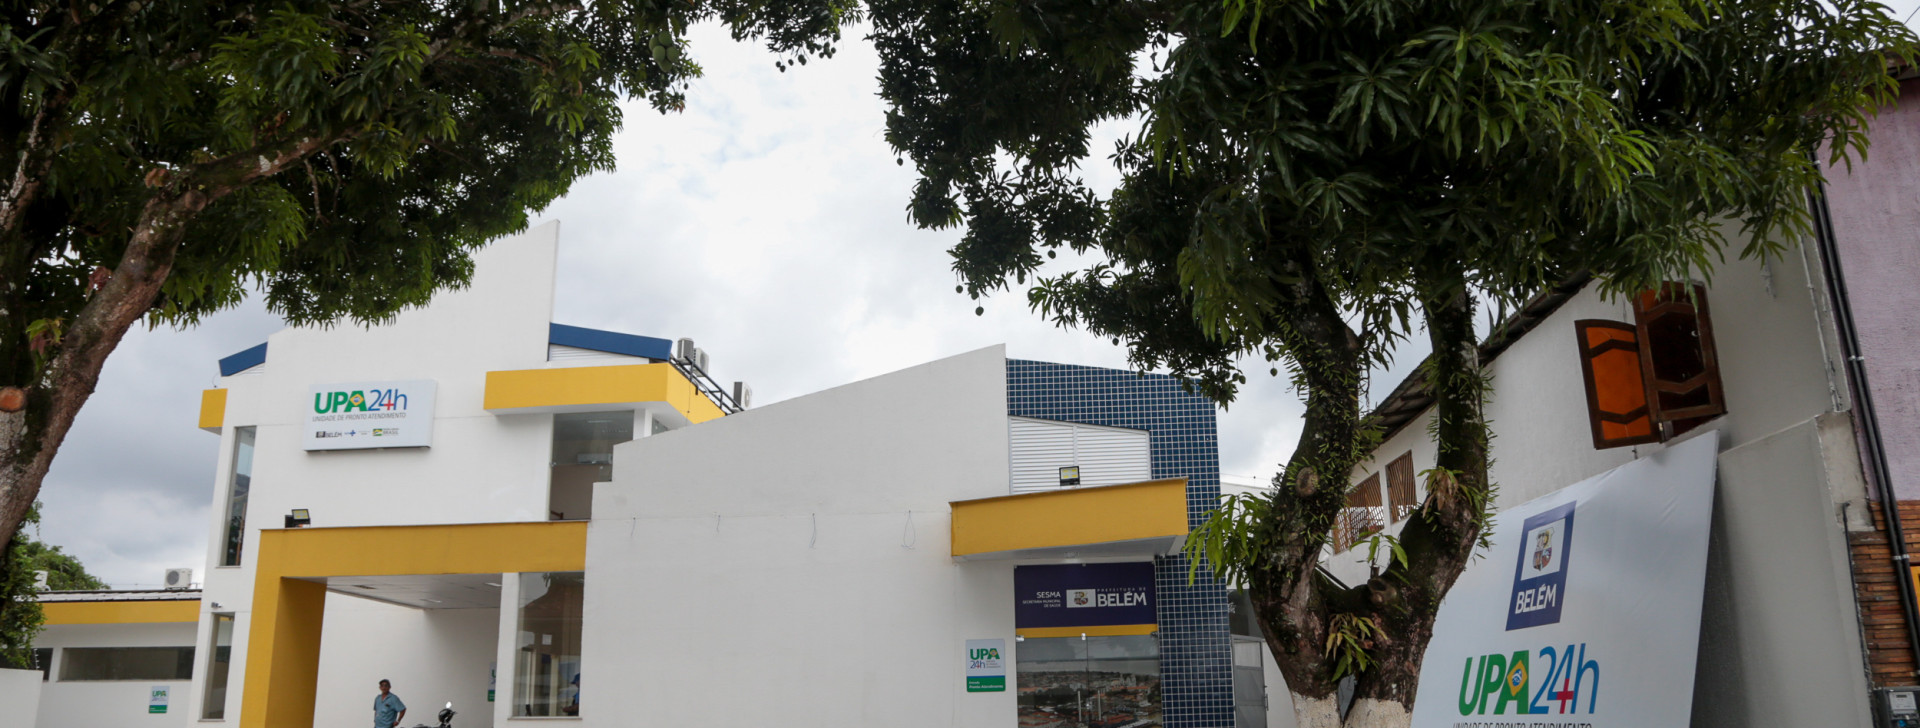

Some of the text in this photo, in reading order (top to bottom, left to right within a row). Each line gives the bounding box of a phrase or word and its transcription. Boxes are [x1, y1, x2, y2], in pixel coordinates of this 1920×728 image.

[314, 388, 408, 414] UPA 24h
[1036, 591, 1061, 599] SESMA
[1097, 591, 1147, 607] BELÉM
[1515, 583, 1557, 614] BELÉM
[970, 648, 1000, 660] UPA
[970, 660, 986, 669] 24h
[1458, 643, 1600, 716] UPA 24h
